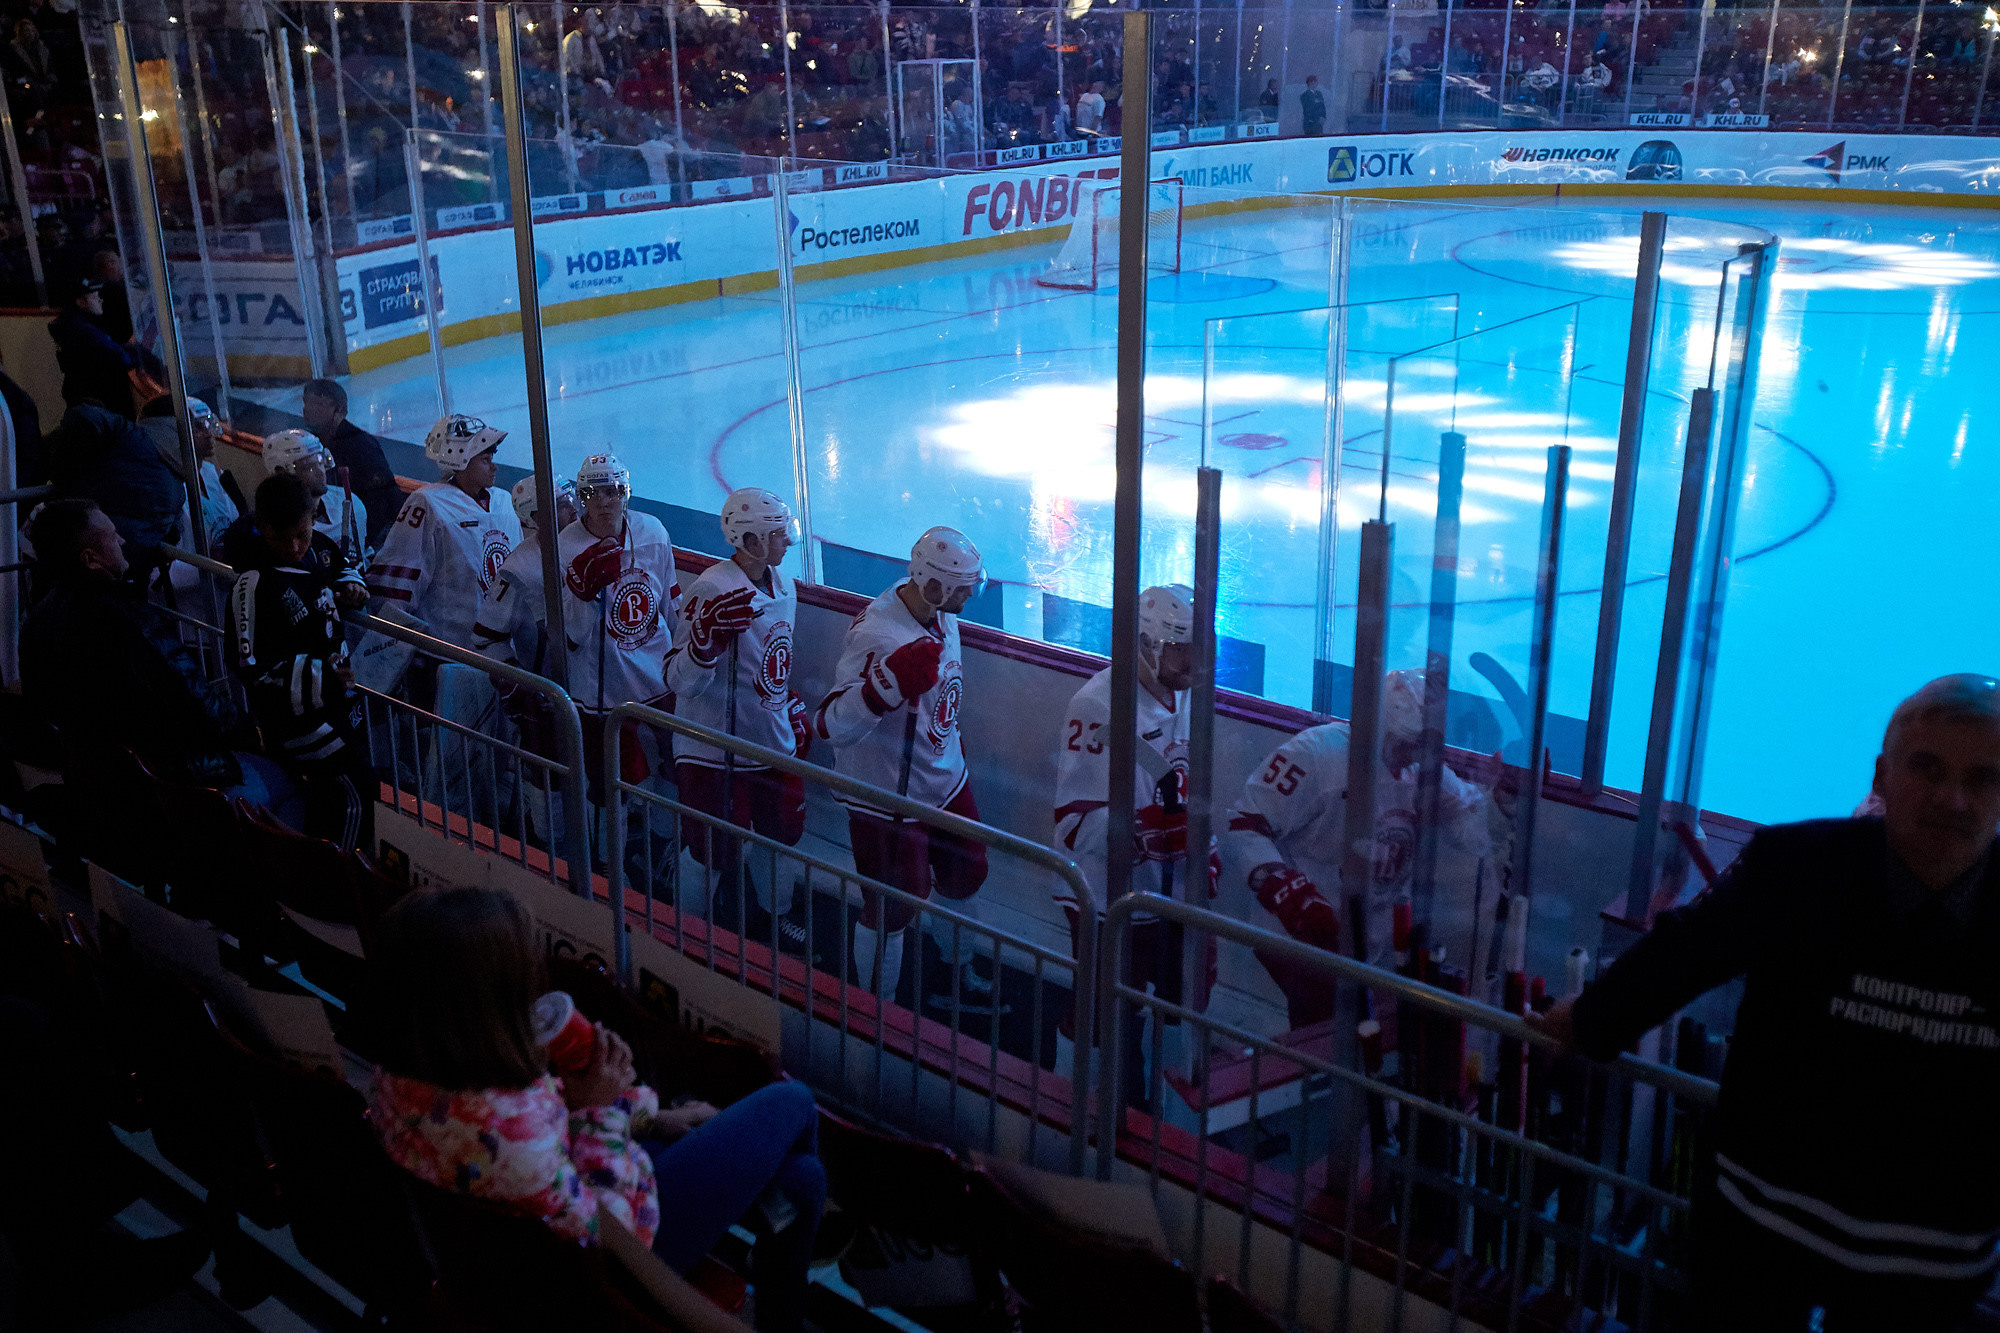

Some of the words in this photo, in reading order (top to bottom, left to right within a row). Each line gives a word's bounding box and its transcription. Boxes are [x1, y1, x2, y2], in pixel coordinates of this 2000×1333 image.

[1637, 114, 1683, 125] KHL.RU
[1714, 115, 1762, 126] KHL.RU
[1002, 147, 1034, 162] KHL.RU
[1051, 142, 1083, 156] KHL.RU
[1211, 163, 1254, 187] БАНК
[1360, 153, 1415, 178] ЮГК
[801, 219, 920, 251] Ростелеком
[566, 241, 683, 277] НОВАТЭК
[1262, 753, 1307, 797] 55
